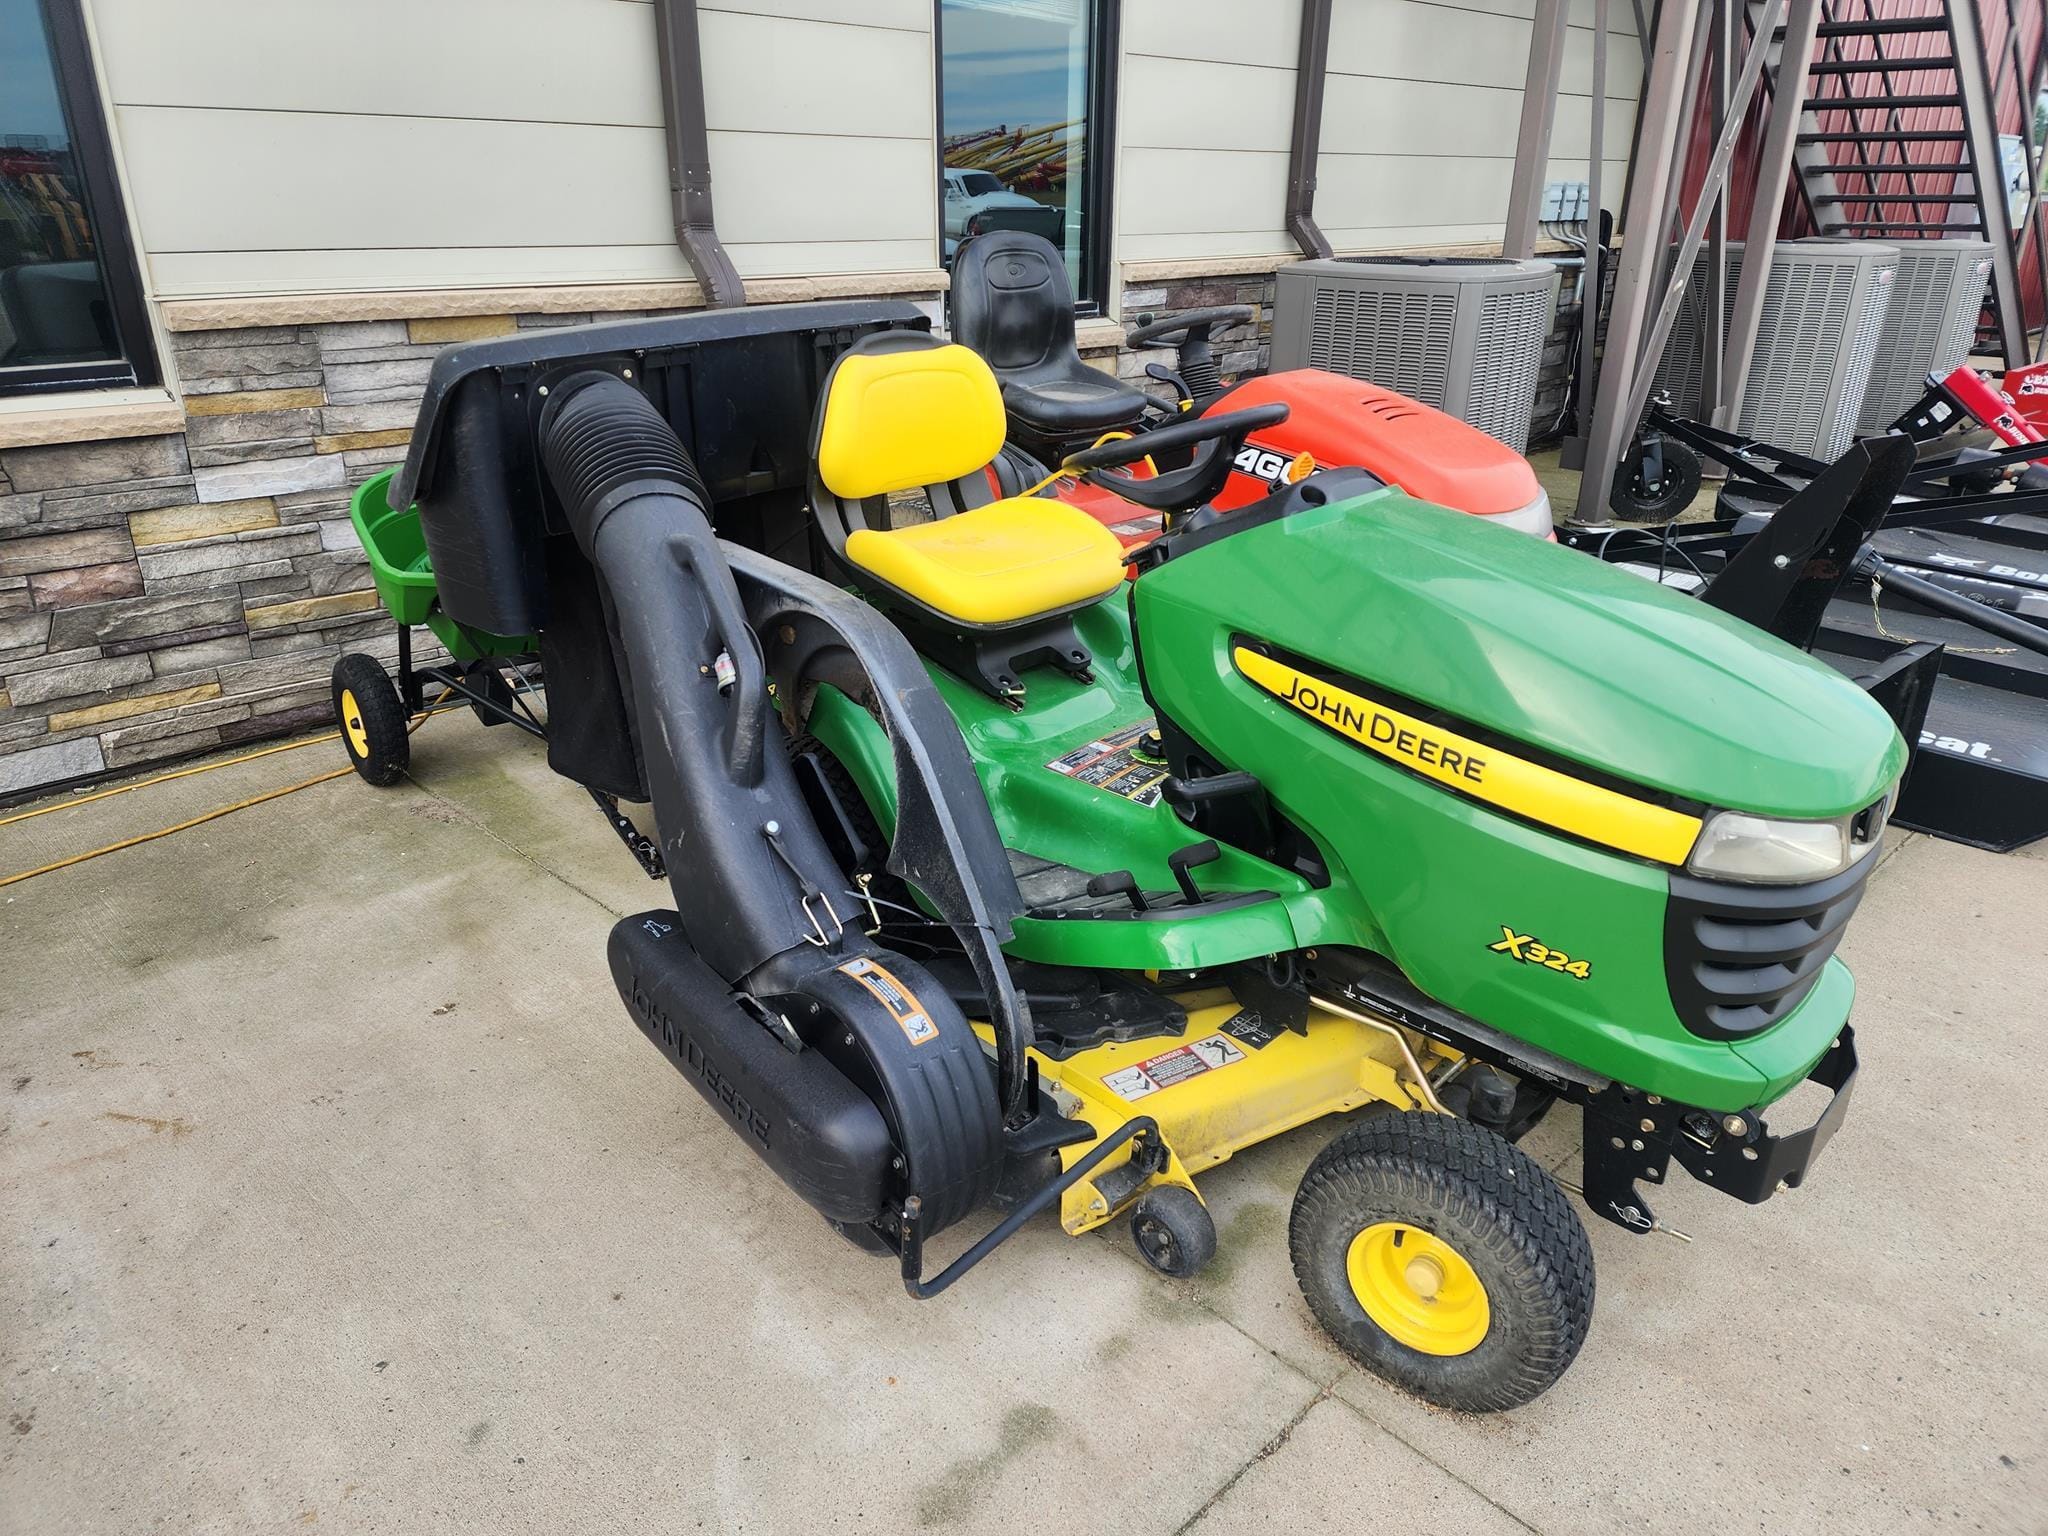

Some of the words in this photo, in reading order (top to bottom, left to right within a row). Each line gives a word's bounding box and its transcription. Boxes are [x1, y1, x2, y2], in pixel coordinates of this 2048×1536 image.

[1281, 677, 1365, 734] JOHN
[1370, 713, 1486, 784] DEERE
[1486, 924, 1593, 980] X324
[623, 975, 683, 1058] JOHN
[687, 1036, 770, 1150] DEERE
